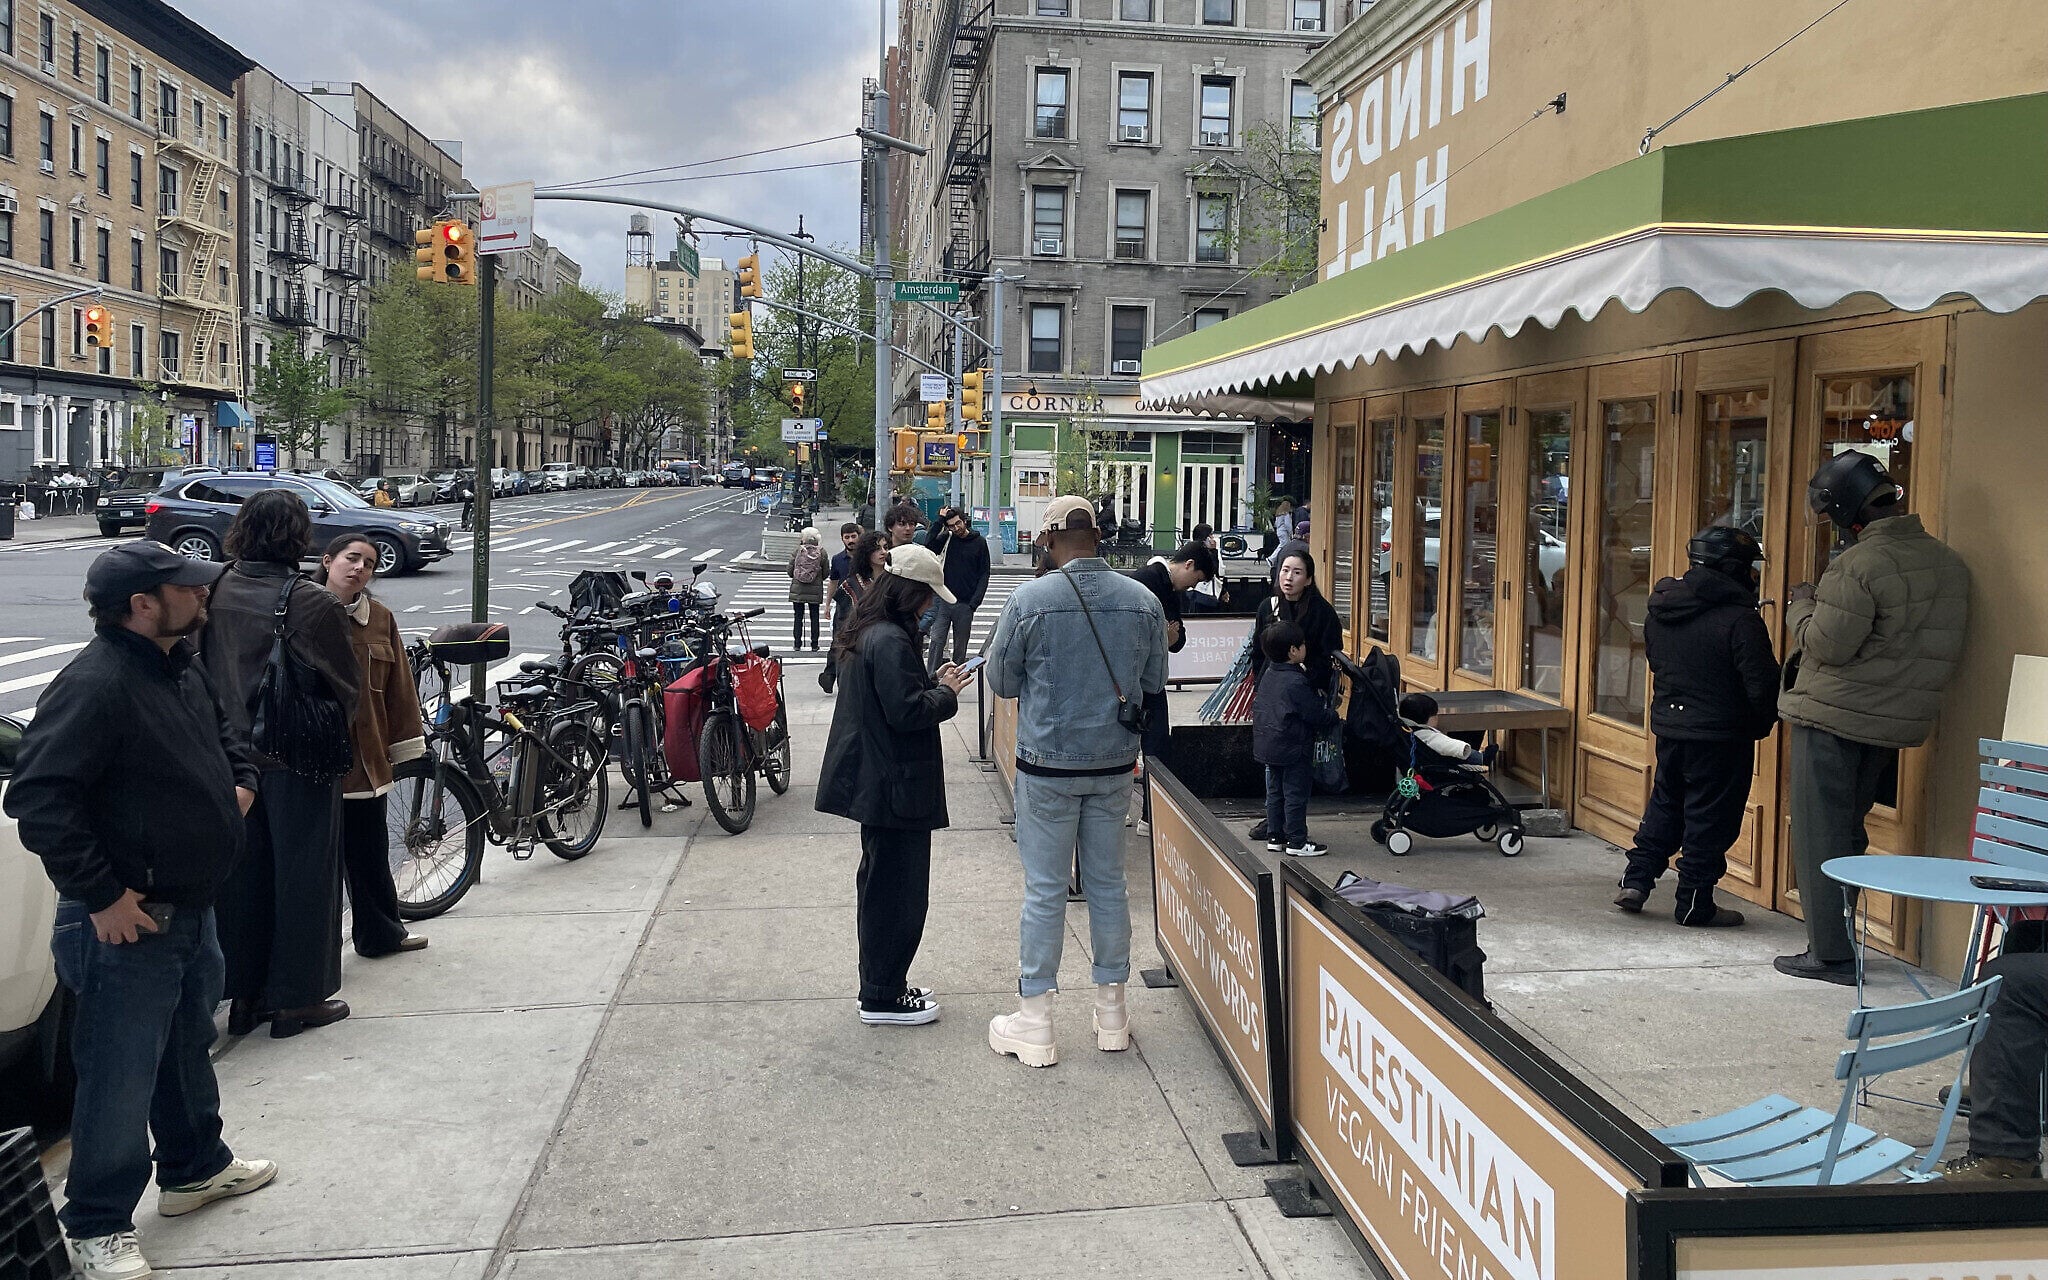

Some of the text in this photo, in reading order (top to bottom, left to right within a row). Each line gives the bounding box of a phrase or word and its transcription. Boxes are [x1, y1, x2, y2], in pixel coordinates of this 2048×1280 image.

[900, 283, 952, 294] Amsterdam
[1010, 395, 1104, 411] CORNER
[1160, 868, 1260, 1052] WITHOUT WORDS
[1162, 833, 1190, 895] CUISINE
[1191, 868, 1212, 924] THAT
[1214, 899, 1255, 980] SPEAKS
[1325, 988, 1542, 1280] PALESTINIAN
[1325, 1076, 1496, 1280] VEGAN FRIEN
